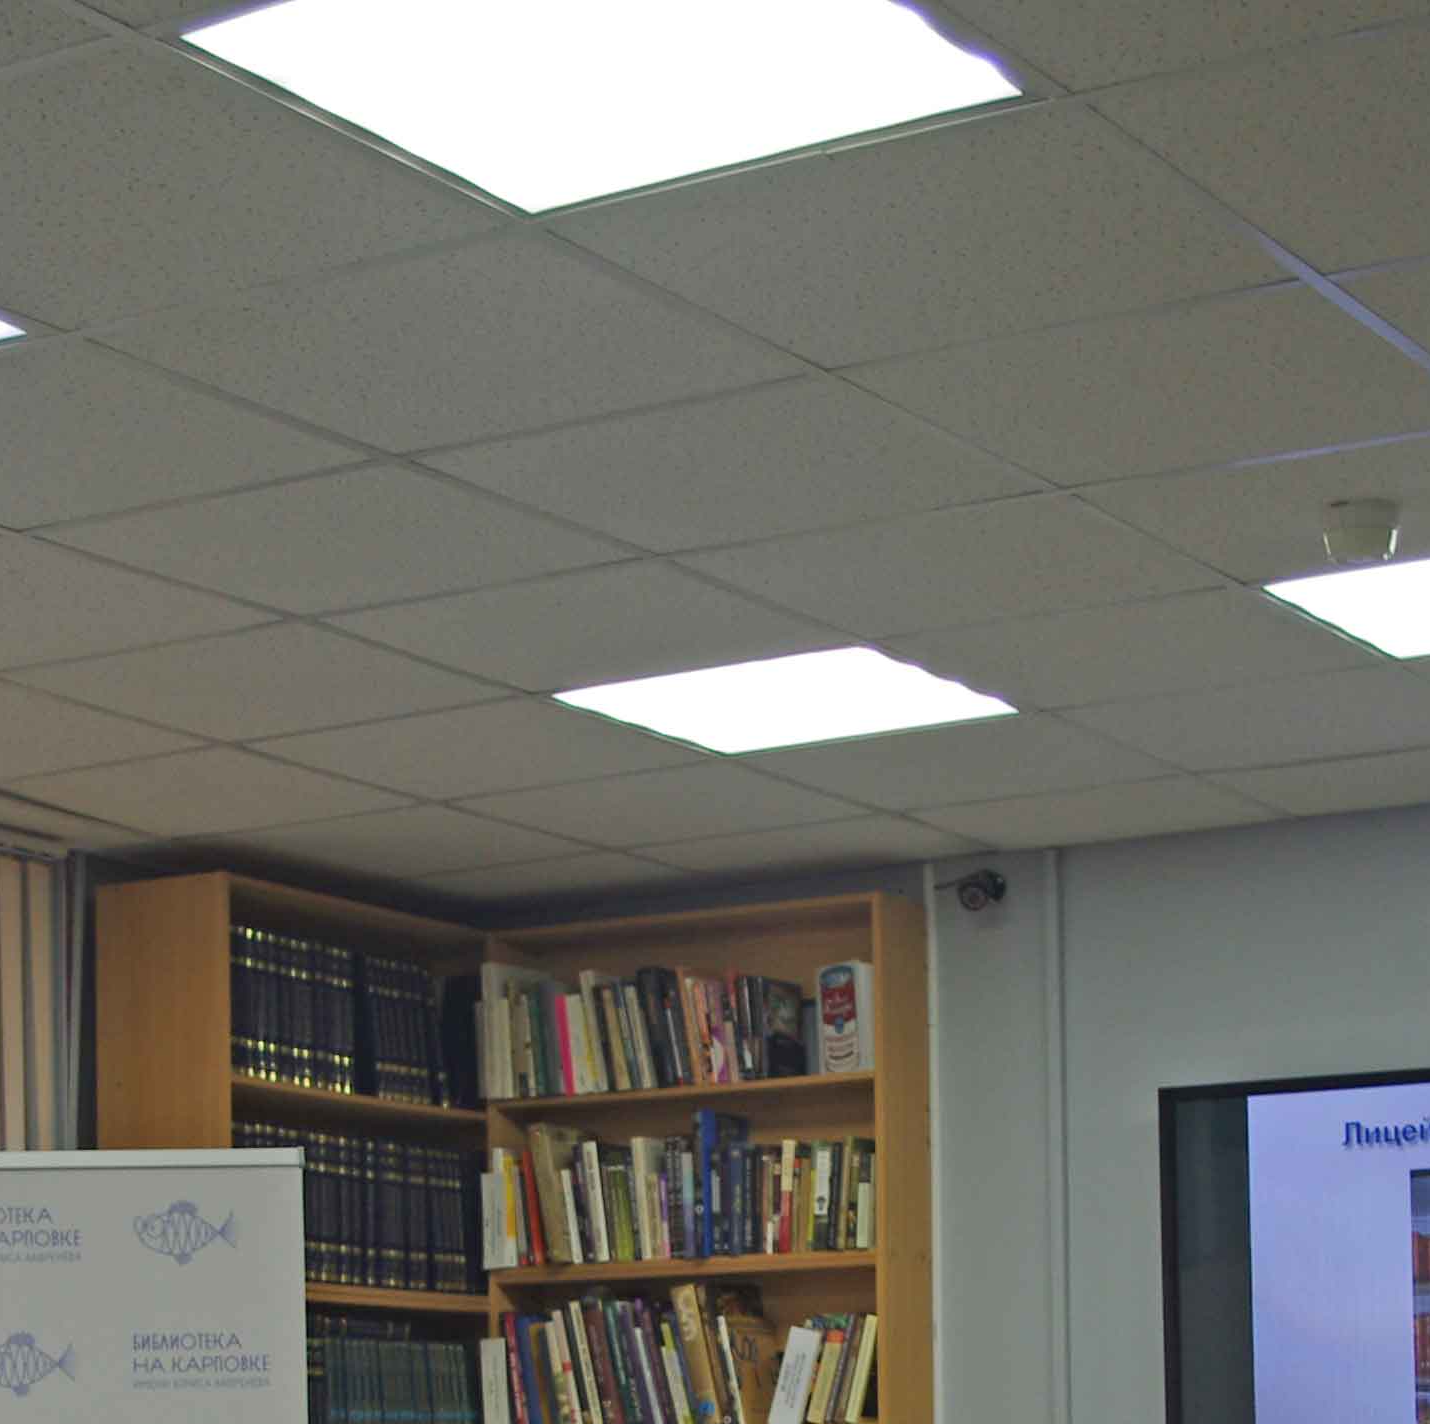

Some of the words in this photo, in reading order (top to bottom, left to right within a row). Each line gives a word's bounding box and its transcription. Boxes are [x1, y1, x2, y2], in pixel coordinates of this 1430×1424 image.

[133, 1332, 243, 1351] БИБЛИОТЕКА
[133, 1357, 165, 1373] НА
[172, 1354, 270, 1374] КАРПОВКЕ
